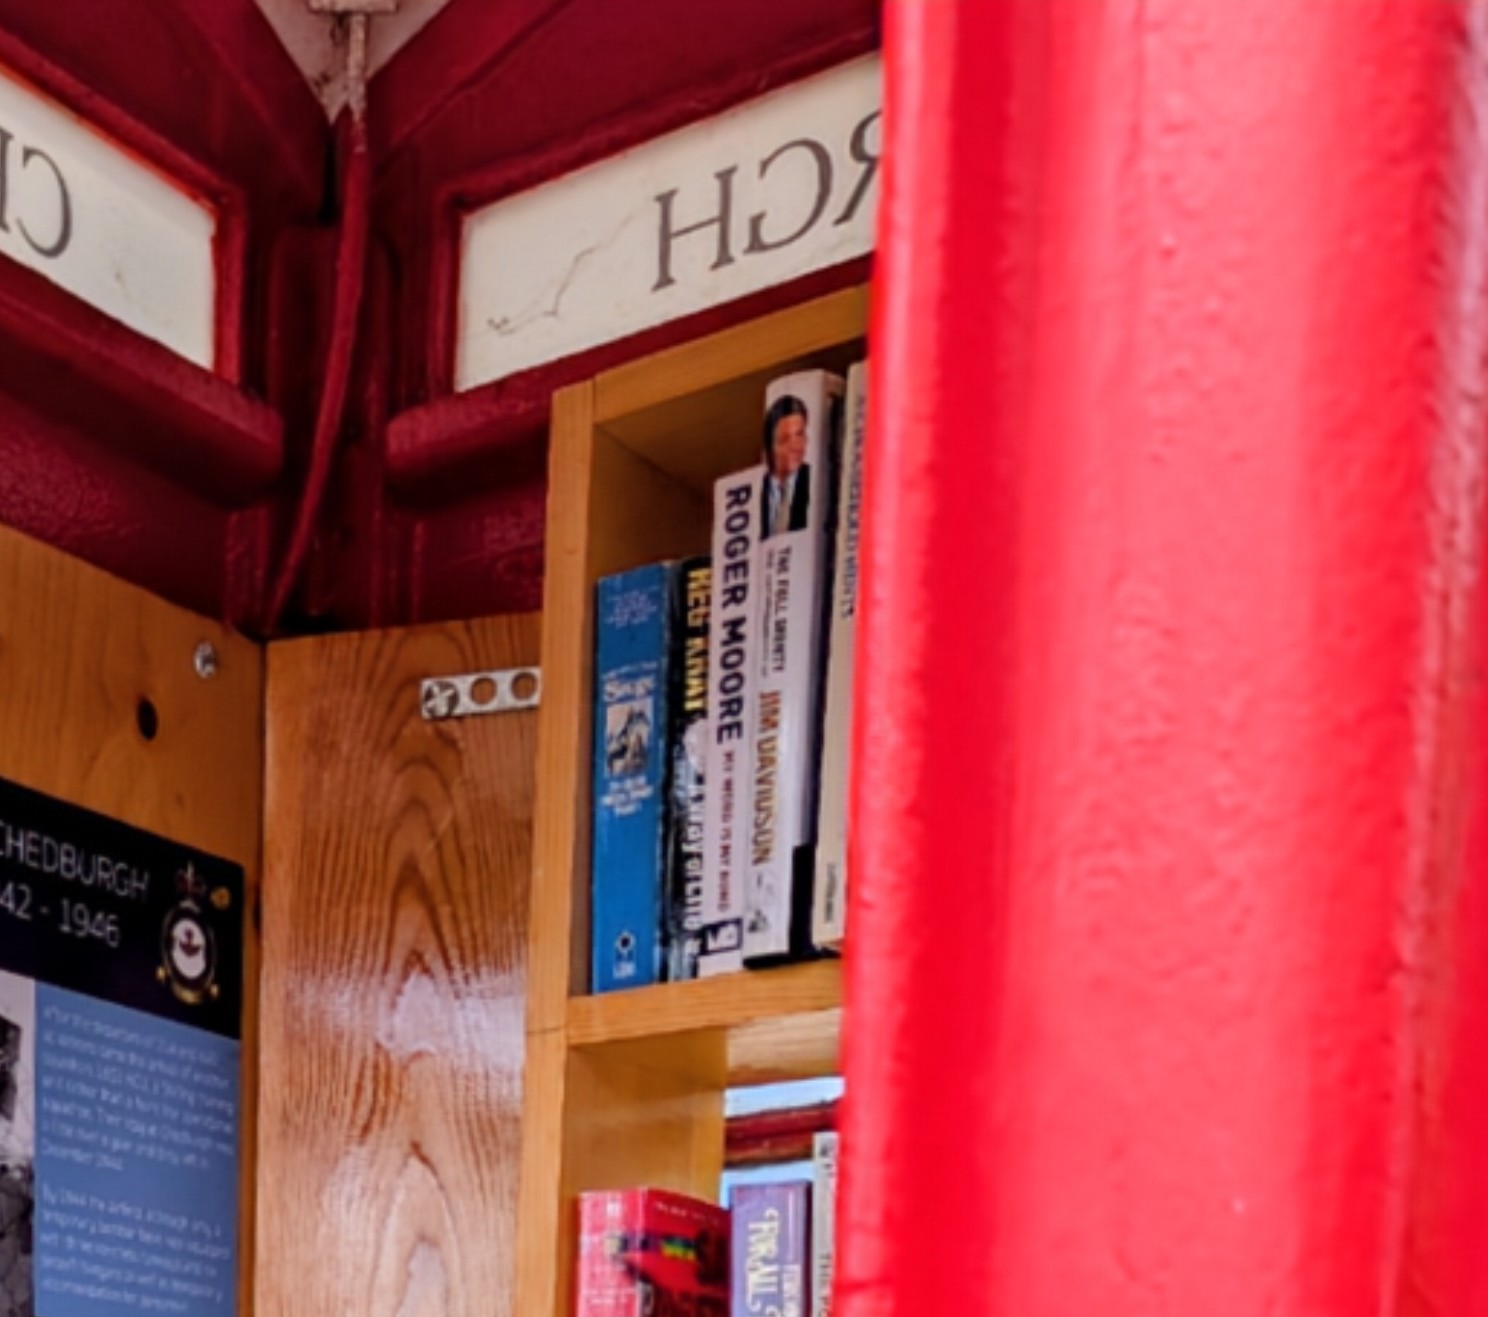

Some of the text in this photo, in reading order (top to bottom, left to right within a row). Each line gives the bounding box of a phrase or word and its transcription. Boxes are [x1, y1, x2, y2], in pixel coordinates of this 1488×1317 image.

[716, 484, 752, 745] ROGER MOORE
[757, 689, 783, 733] JIM
[751, 735, 778, 866] DAVIDSON
[60, 896, 119, 949] 1946
